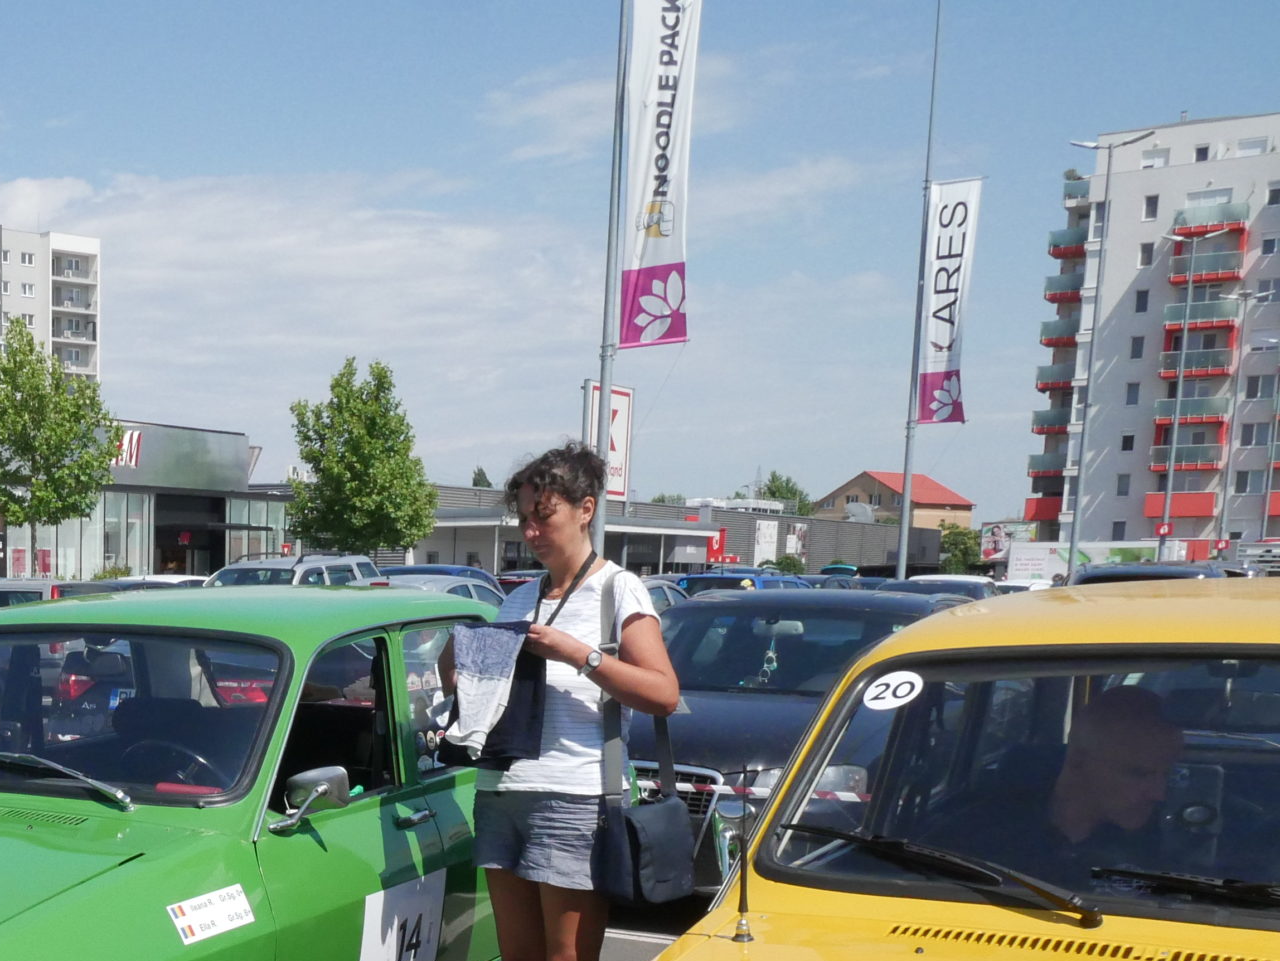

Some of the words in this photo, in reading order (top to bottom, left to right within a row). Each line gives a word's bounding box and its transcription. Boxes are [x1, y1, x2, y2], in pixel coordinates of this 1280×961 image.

[653, 75, 678, 197] NOODLE
[932, 200, 968, 326] ARES
[868, 681, 915, 701] 20
